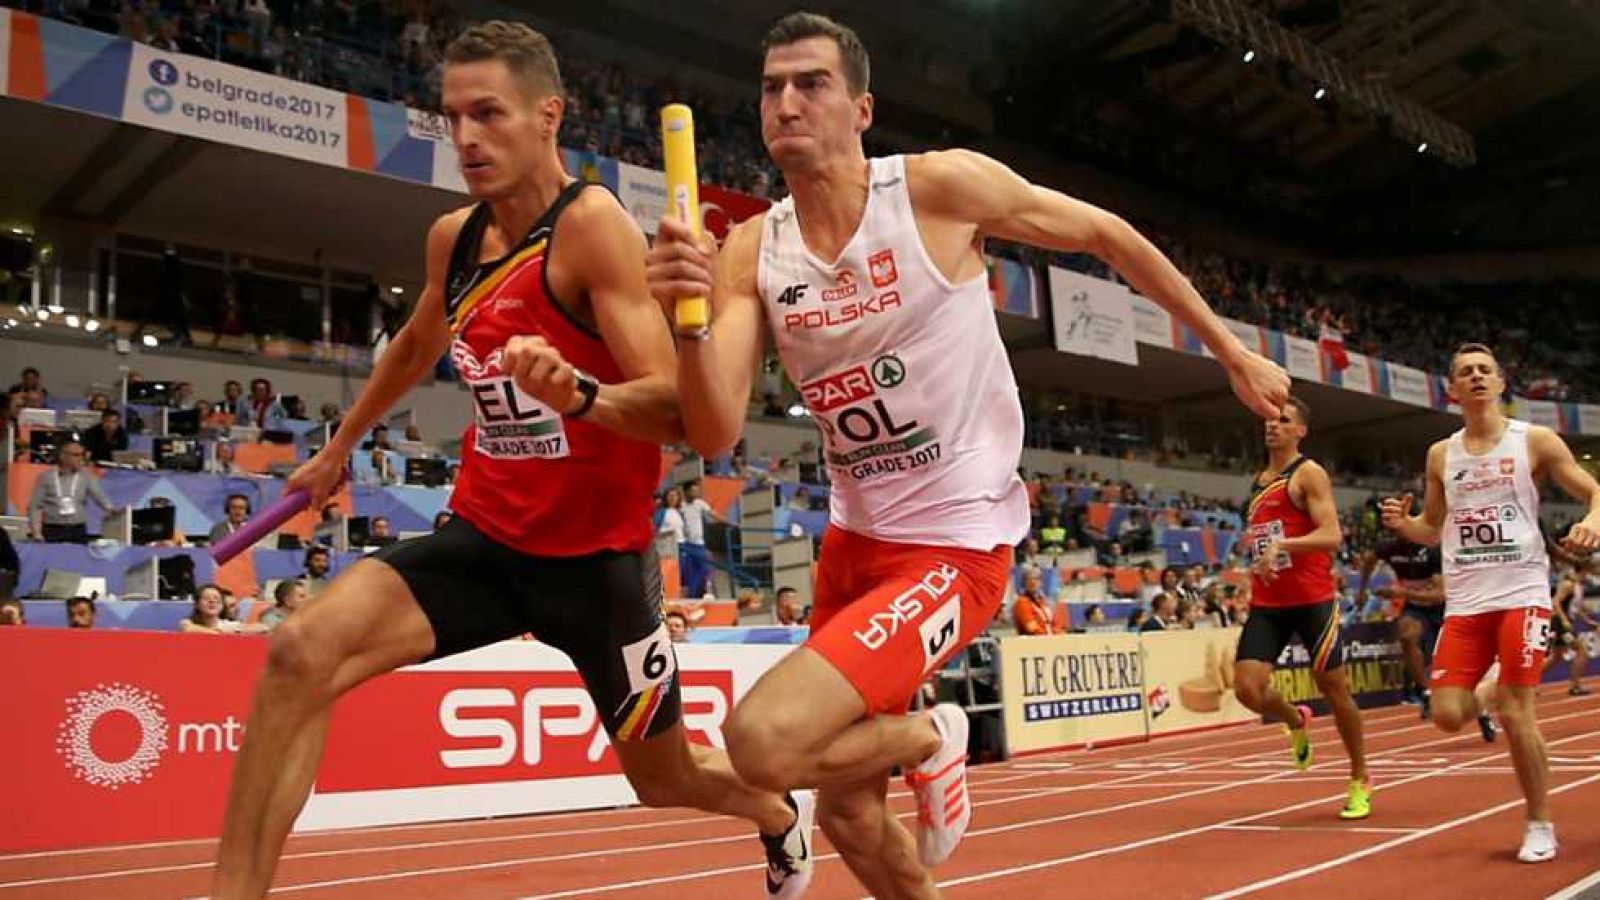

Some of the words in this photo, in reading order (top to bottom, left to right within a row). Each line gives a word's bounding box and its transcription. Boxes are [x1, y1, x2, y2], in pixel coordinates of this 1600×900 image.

[186, 71, 336, 120] belgrade2017
[181, 102, 341, 148] epatletika2017
[776, 284, 808, 305] 4F
[784, 290, 902, 332] POLSKA
[803, 372, 872, 405] PAR
[905, 443, 942, 469] 2017
[1460, 522, 1515, 547] POL
[853, 561, 959, 650] POLSKA
[928, 617, 955, 656] 5
[642, 641, 668, 680] 6
[1020, 656, 1048, 697] LE
[1052, 643, 1143, 694] GRUYÈRE
[1027, 694, 1140, 720] SWITZERLAND
[178, 716, 247, 753] mt
[439, 685, 728, 769] SPR
